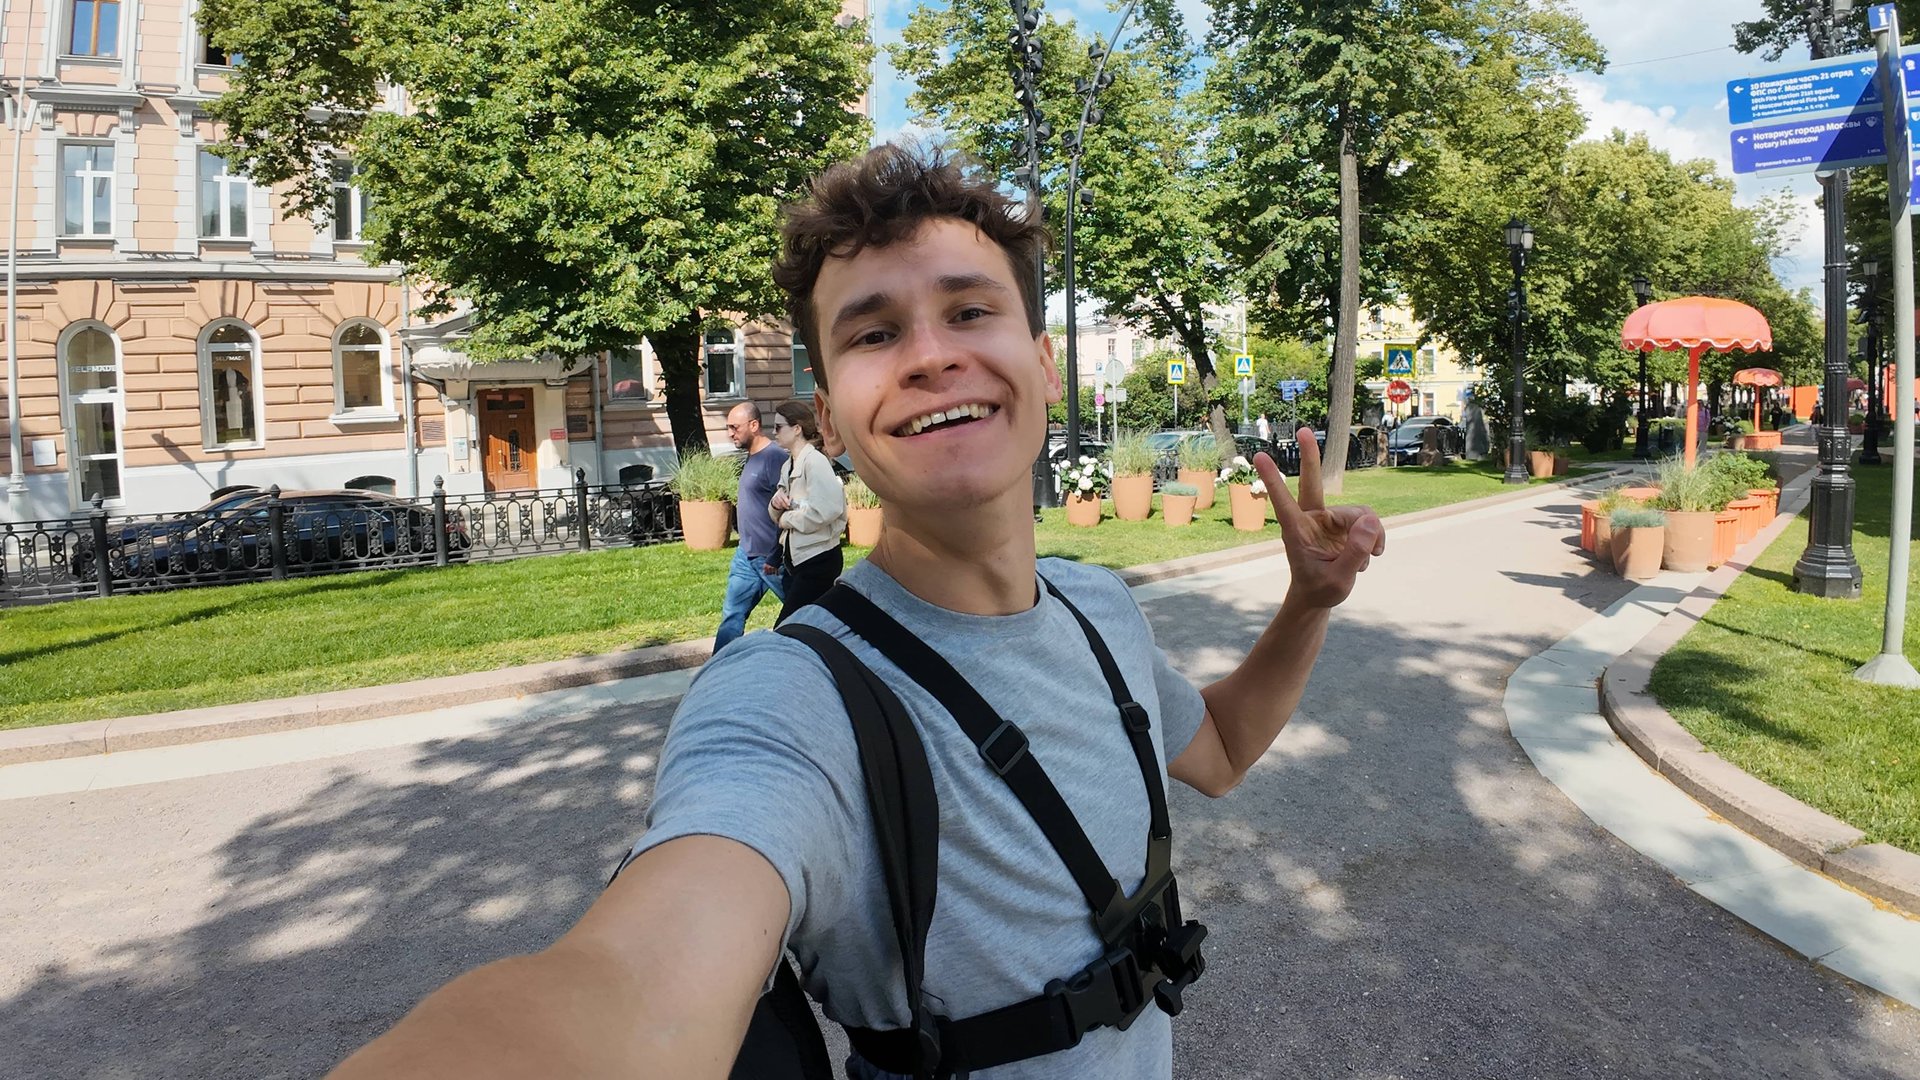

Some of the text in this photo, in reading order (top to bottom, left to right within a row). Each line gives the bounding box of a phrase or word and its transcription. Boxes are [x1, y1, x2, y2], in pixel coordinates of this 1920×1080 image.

[1760, 78, 1798, 89] Пожарная
[1798, 75, 1819, 83] часть
[1820, 72, 1830, 80] 21
[1830, 70, 1853, 79] отряд
[1750, 88, 1767, 96] ФПС
[1784, 83, 1812, 92] Москве
[1814, 87, 1834, 96] squad
[1783, 98, 1805, 107] Federal
[1818, 94, 1840, 102] Service
[1753, 121, 1860, 140] Нотариус города Москвы
[1753, 139, 1779, 150] Notary
[1788, 135, 1818, 146] Moscow
